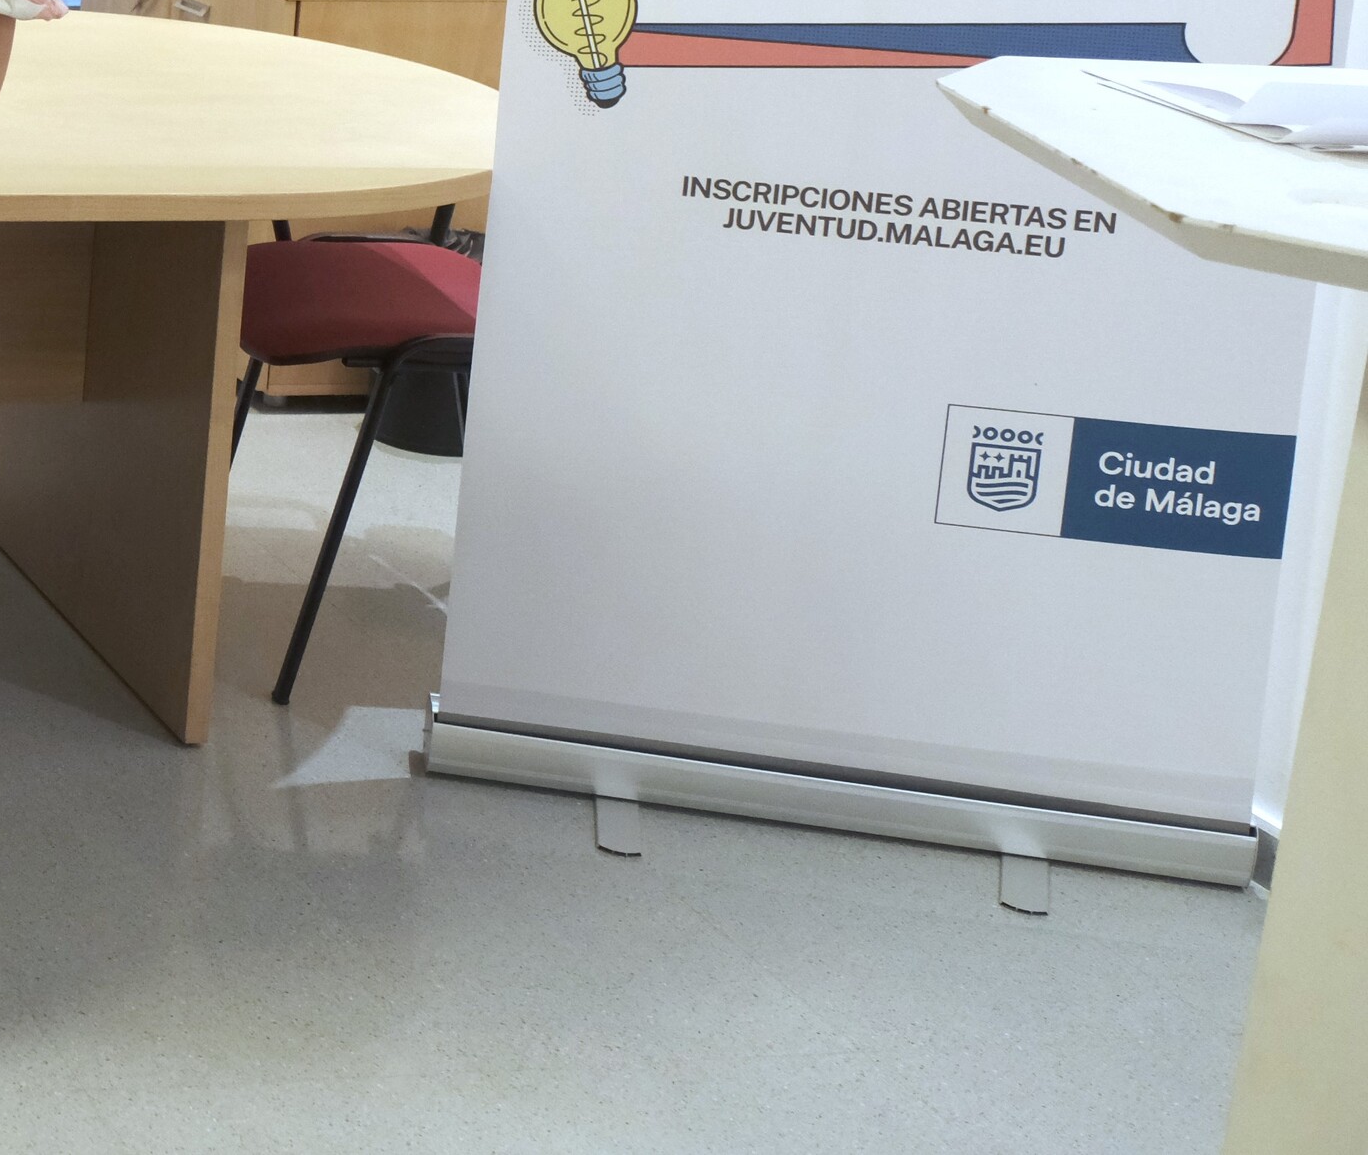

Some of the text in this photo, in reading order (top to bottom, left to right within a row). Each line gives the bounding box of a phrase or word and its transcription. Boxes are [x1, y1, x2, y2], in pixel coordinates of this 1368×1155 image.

[681, 176, 1117, 234] INSCRIPCIONES ABIERTAS EN
[722, 207, 1066, 258] JUVENTUD.MALAGA.EU
[1098, 451, 1216, 486] Ciudad
[1094, 485, 1261, 526] de Málaga
